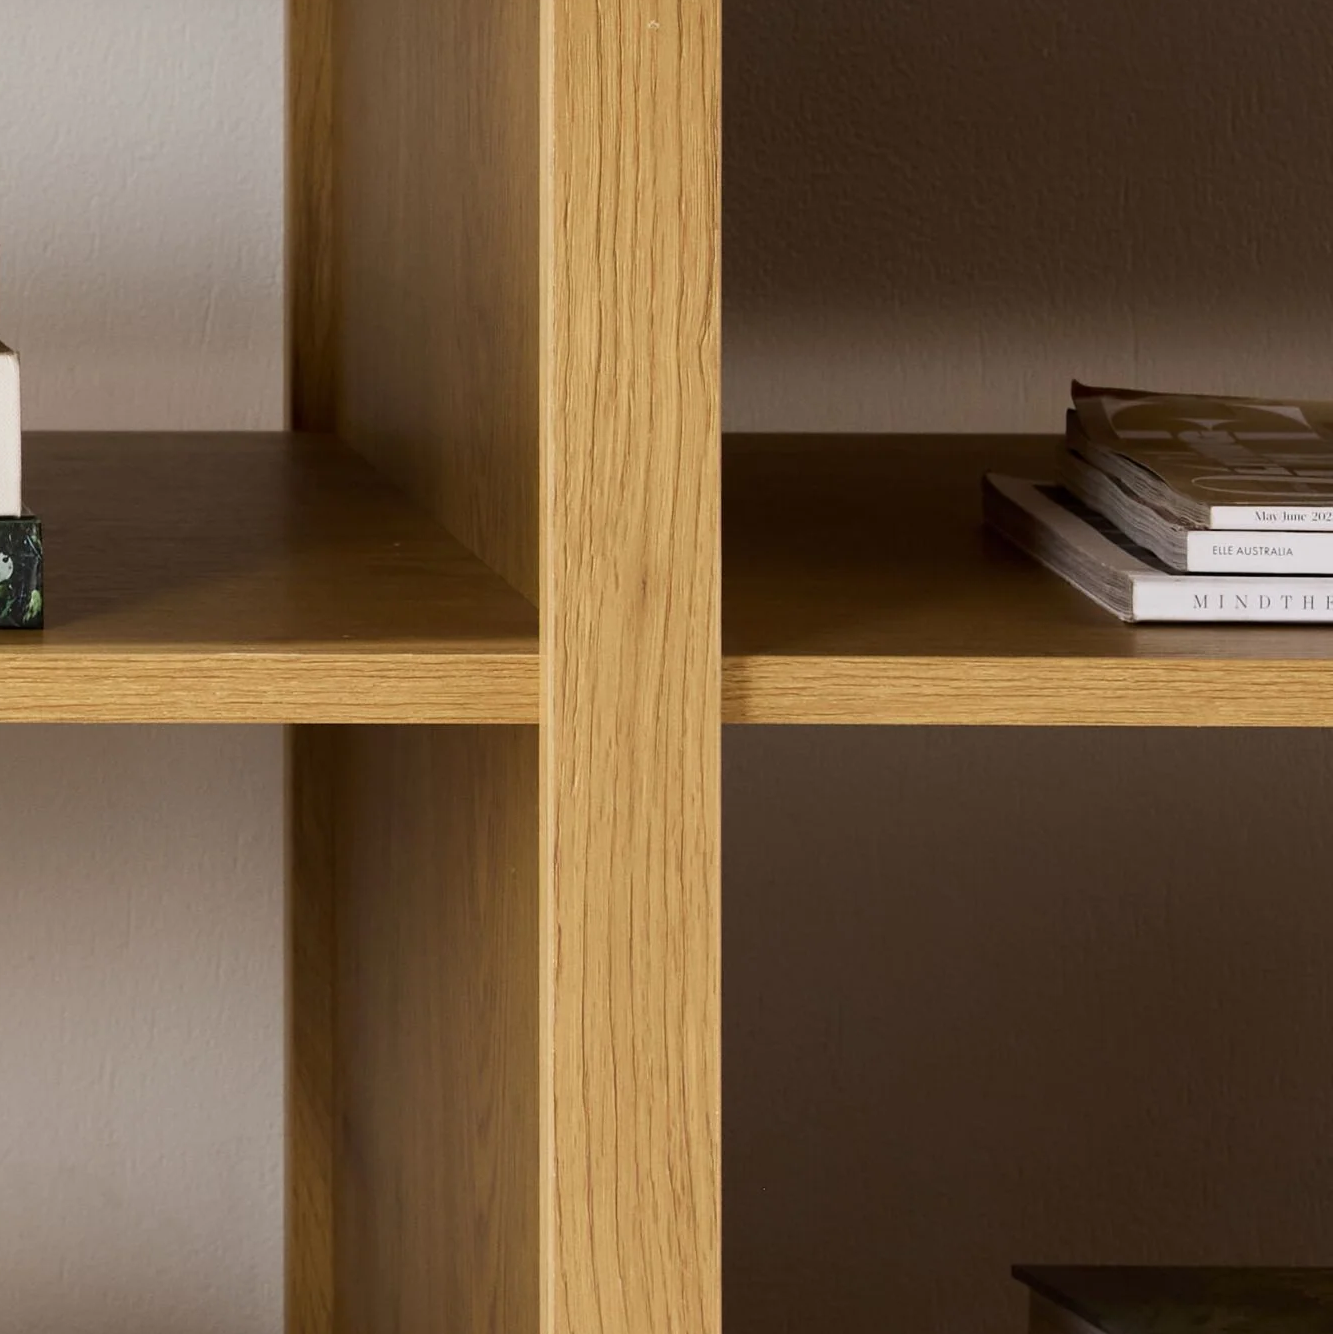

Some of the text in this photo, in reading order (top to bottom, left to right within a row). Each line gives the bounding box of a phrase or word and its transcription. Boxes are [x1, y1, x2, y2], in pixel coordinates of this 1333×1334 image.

[1255, 511, 1277, 523] May
[1283, 511, 1307, 522] June
[1212, 545, 1294, 557] ELLE AUSTRALIA
